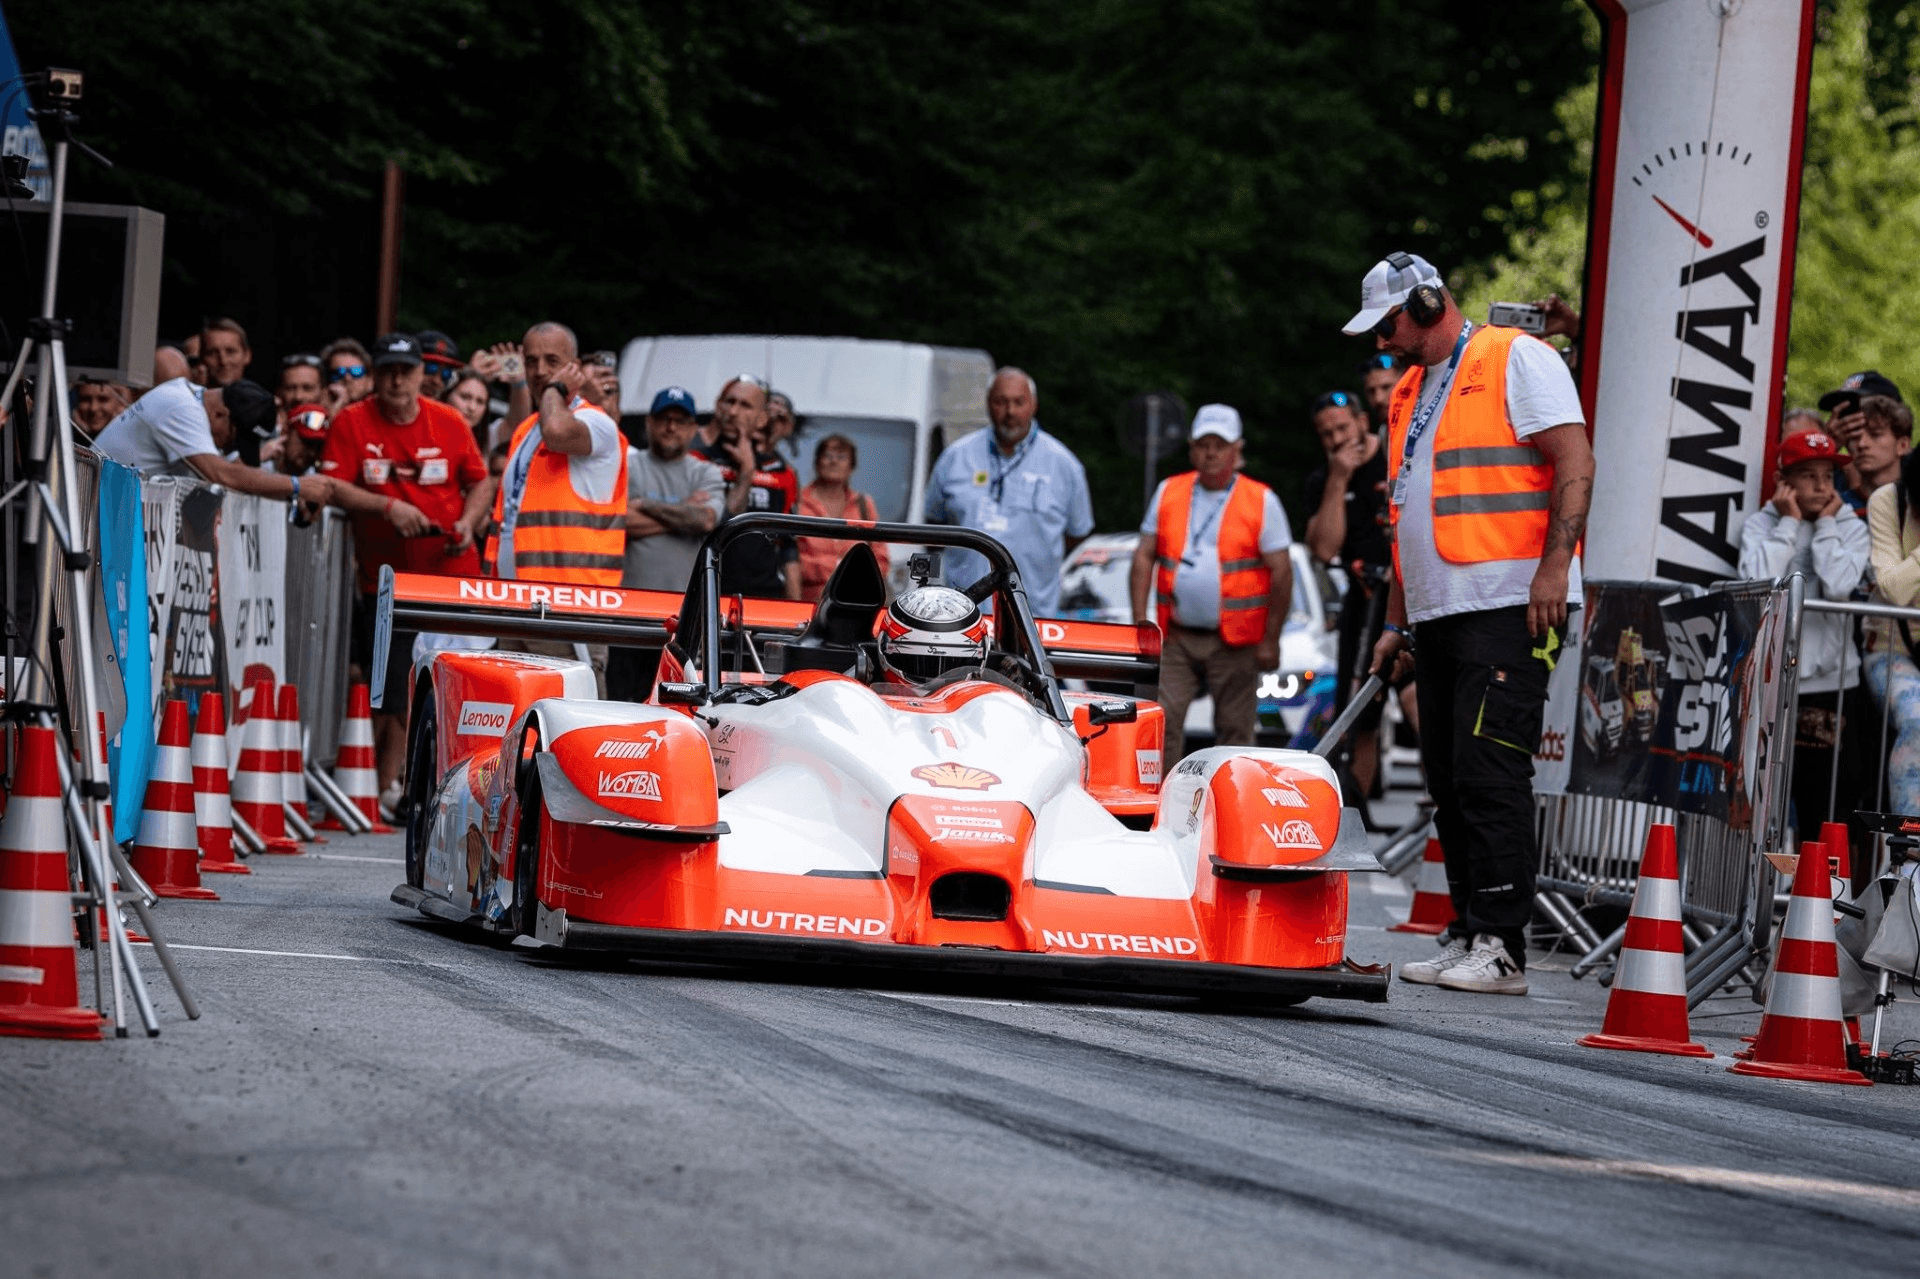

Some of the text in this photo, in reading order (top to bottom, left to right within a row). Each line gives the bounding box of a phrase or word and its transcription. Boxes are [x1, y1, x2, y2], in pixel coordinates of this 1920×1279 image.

[1655, 236, 1766, 588] AMAX
[459, 580, 623, 609] NUTREND
[667, 684, 692, 693] PUMA
[462, 707, 505, 728] Lenovo
[1101, 702, 1126, 712] PUMA
[593, 740, 654, 759] PUMA
[598, 769, 663, 802] WOMBAT
[1260, 787, 1308, 808] PUMA
[724, 907, 888, 937] NUTREND
[1042, 929, 1197, 956] NUTREND
